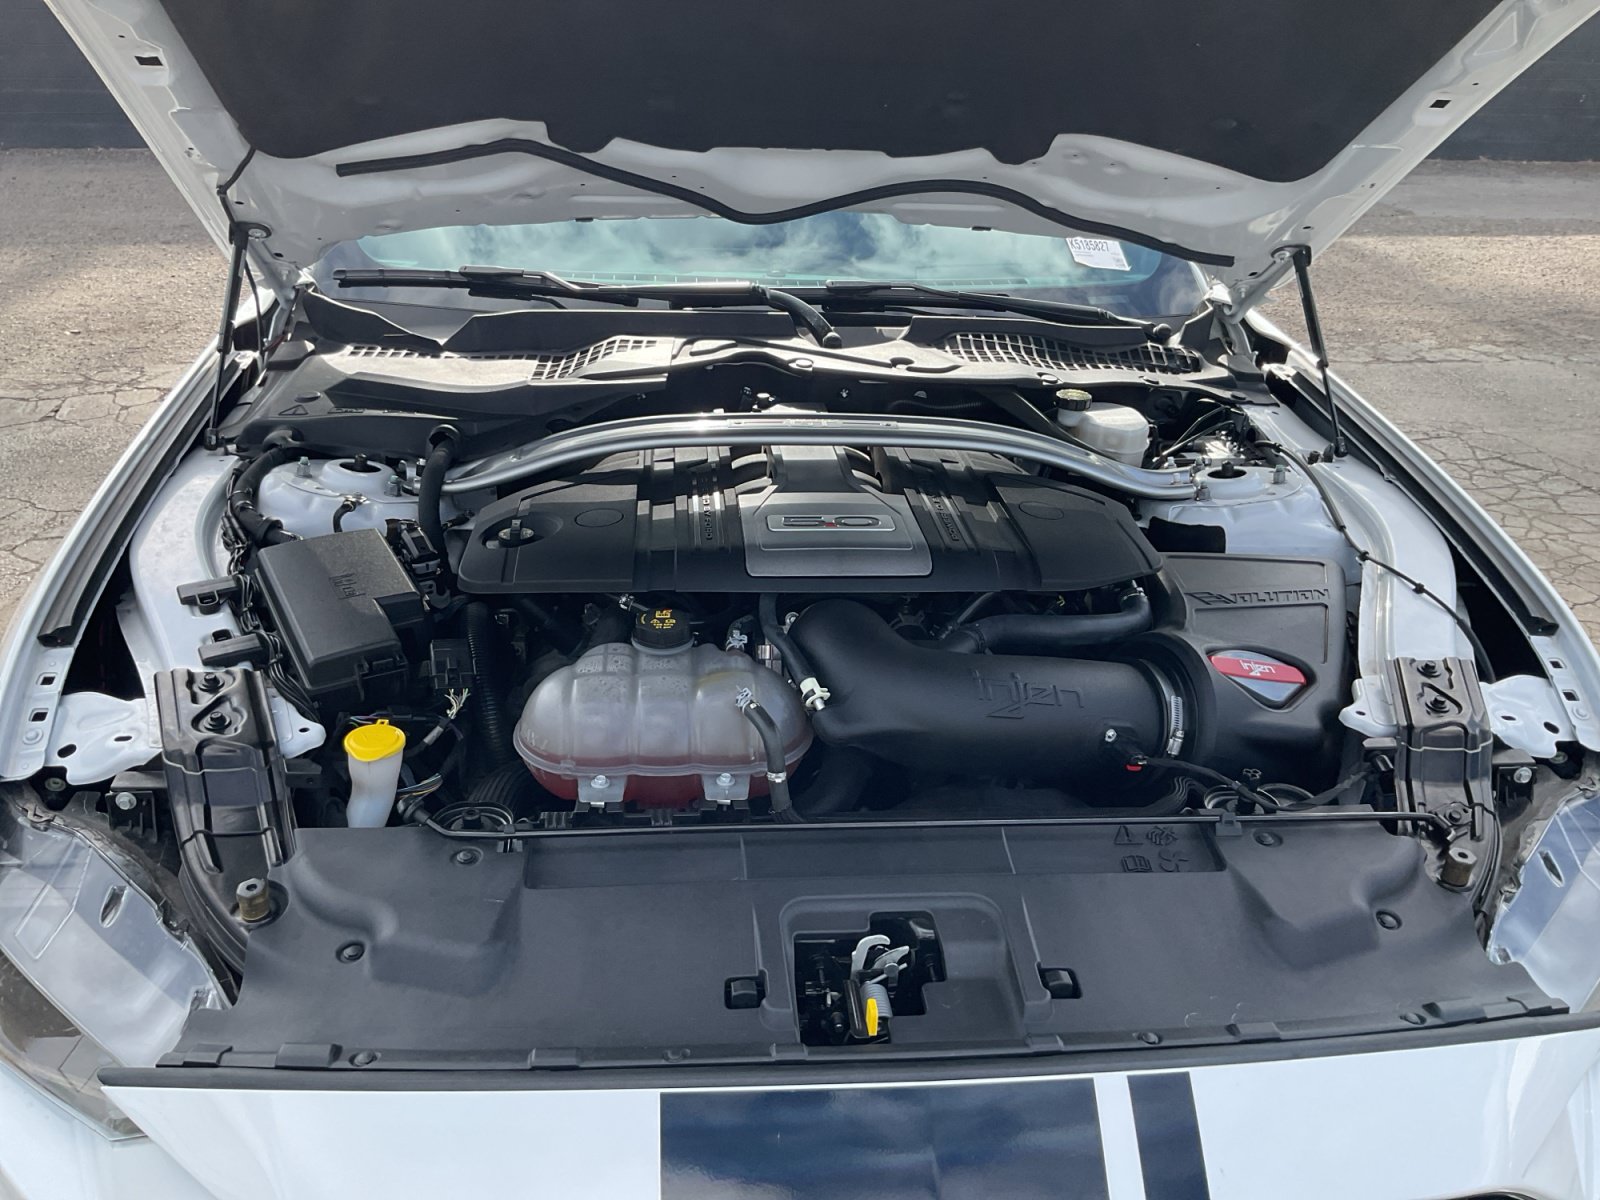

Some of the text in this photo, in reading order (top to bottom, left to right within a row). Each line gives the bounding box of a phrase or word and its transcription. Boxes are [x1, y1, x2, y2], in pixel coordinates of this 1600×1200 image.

[1069, 239, 1110, 252] K5185827
[782, 515, 883, 528] 5.0
[1185, 588, 1331, 606] EVOLUTION
